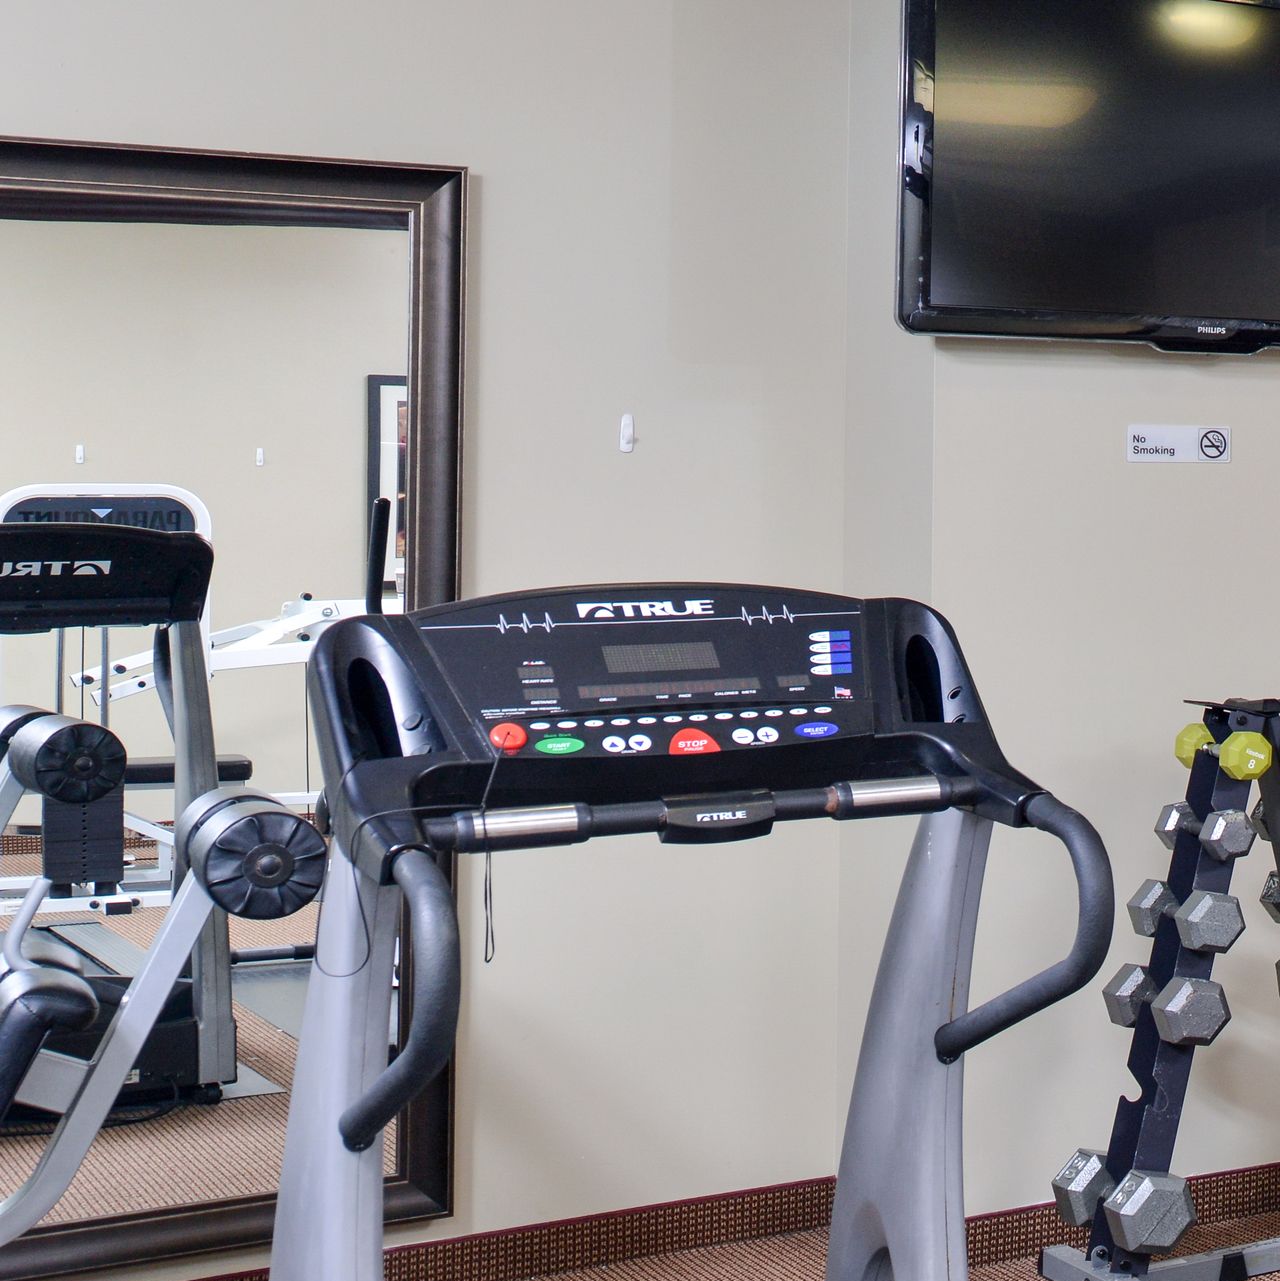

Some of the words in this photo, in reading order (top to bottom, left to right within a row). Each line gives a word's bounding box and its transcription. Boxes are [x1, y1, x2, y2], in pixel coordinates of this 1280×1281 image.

[1197, 326, 1226, 334] PHILIPS
[1132, 434, 1146, 443] No
[1132, 445, 1175, 457] Smoking
[612, 600, 714, 617] TRUE
[678, 739, 708, 748] STOP
[1247, 759, 1256, 769] 8
[711, 810, 747, 821] TRUE
